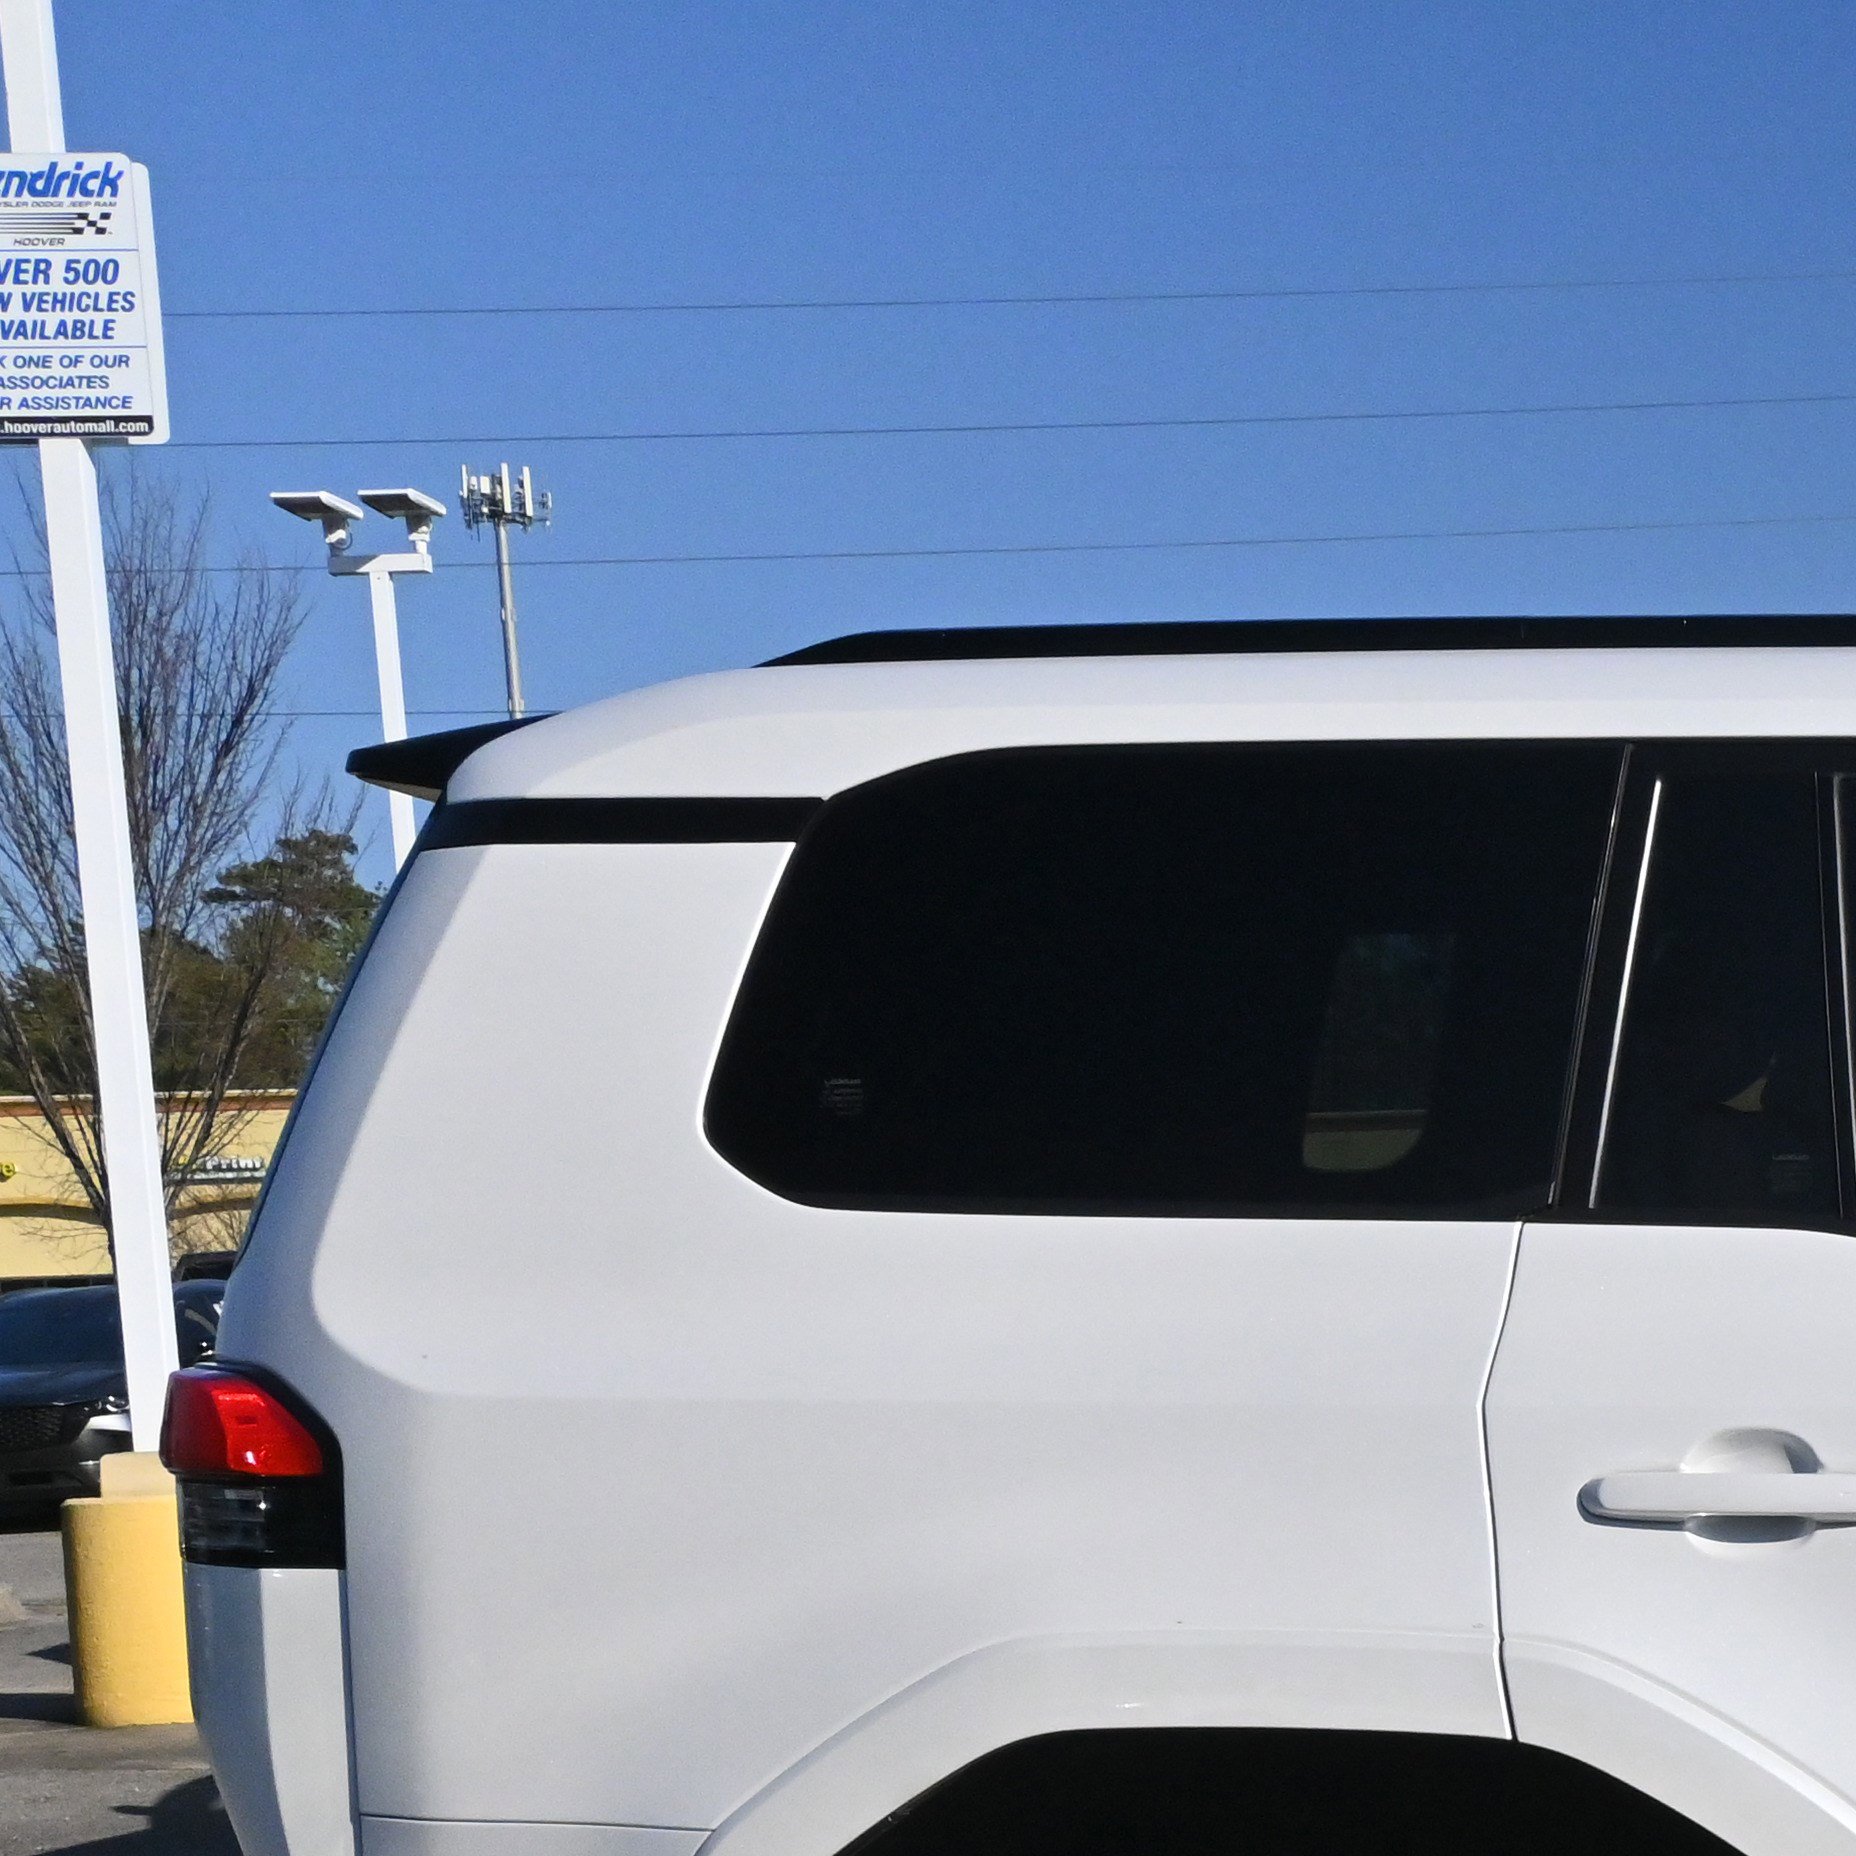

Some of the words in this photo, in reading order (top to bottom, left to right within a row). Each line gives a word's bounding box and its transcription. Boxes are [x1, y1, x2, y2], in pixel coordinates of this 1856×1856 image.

[0, 161, 125, 198] ndrick
[13, 238, 66, 246] HOOVER
[0, 258, 52, 285] VER
[62, 258, 120, 285] 500
[21, 291, 136, 312] VEHICLES
[0, 319, 117, 340] VAILABLE
[13, 355, 53, 369] ONE
[59, 355, 85, 369] OF
[90, 354, 131, 368] OUR
[18, 396, 134, 410] ASSISTANCE
[0, 420, 149, 434] .hooverautomall.com
